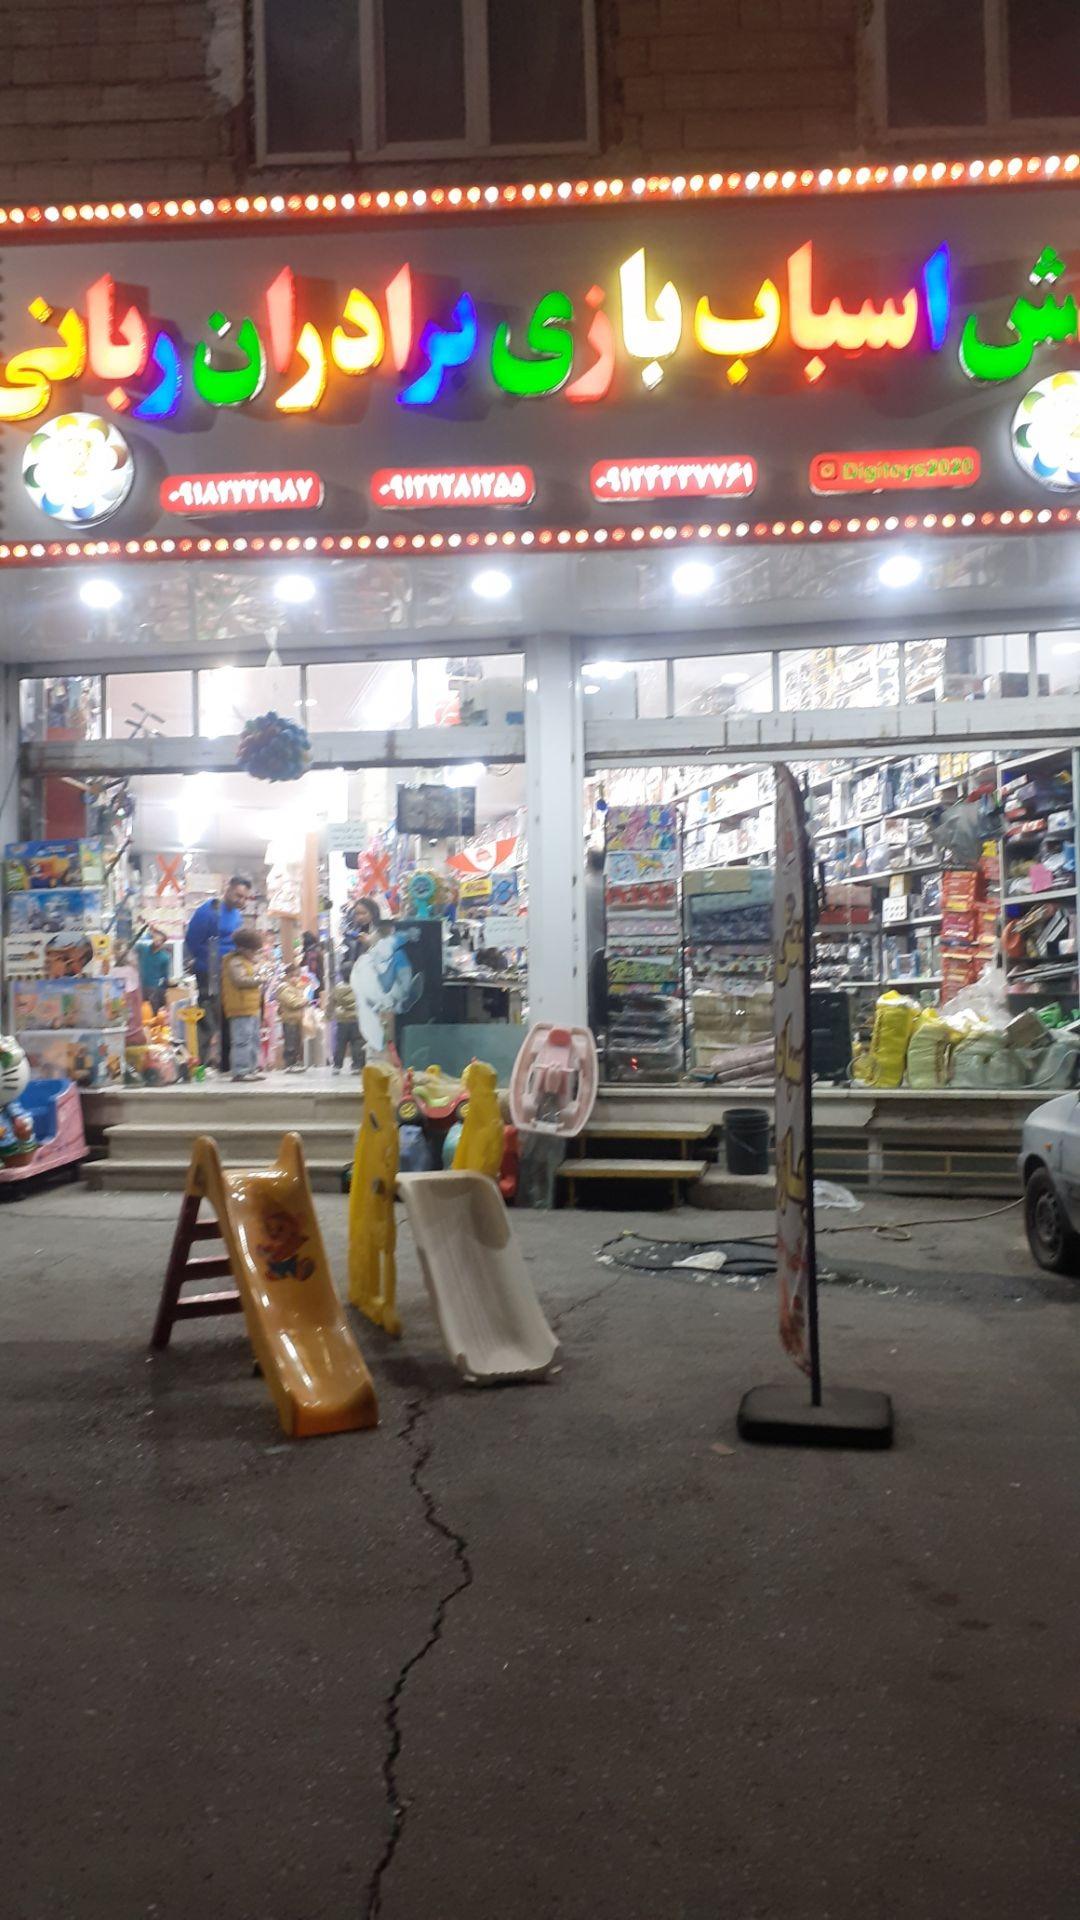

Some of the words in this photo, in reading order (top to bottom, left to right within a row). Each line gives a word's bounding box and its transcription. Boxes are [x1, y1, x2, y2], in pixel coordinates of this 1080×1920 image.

[0, 272, 183, 421] ربانی
[192, 262, 478, 413] برادران
[491, 247, 683, 403] بازی
[694, 240, 952, 385] اسباب
[842, 456, 975, 484] Digitoys2020
